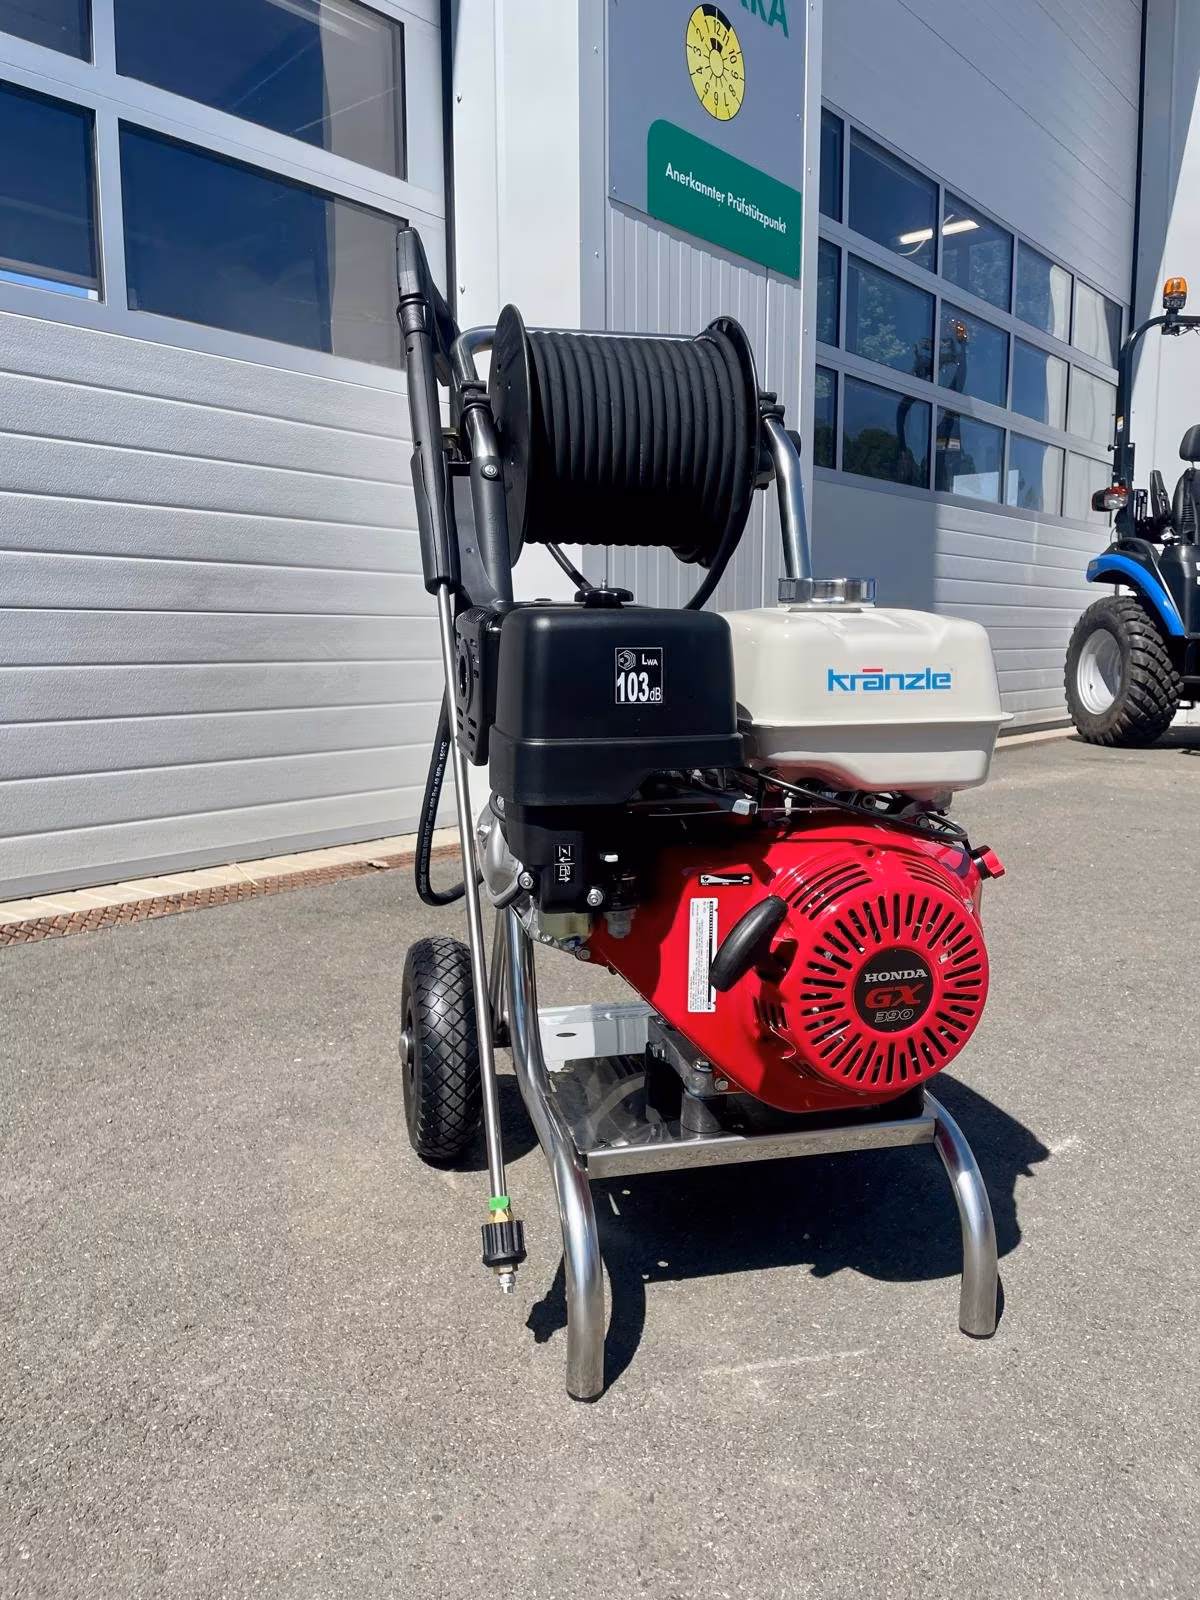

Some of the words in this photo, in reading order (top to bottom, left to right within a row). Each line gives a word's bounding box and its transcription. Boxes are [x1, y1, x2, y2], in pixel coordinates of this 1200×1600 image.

[695, 27, 705, 42] 2
[713, 19, 721, 37] 12
[722, 31, 730, 46] 11
[693, 45, 702, 57] 3
[728, 49, 738, 64] 10
[695, 66, 703, 75] 4
[730, 69, 739, 80] 9
[703, 81, 710, 95] 5
[728, 84, 737, 97] 8
[665, 162, 726, 203] Anerkannter
[727, 192, 787, 234] Prüfstützpunkt
[864, 968, 928, 983] HONDA
[865, 982, 925, 1009] GX
[874, 1008, 915, 1023] 390
